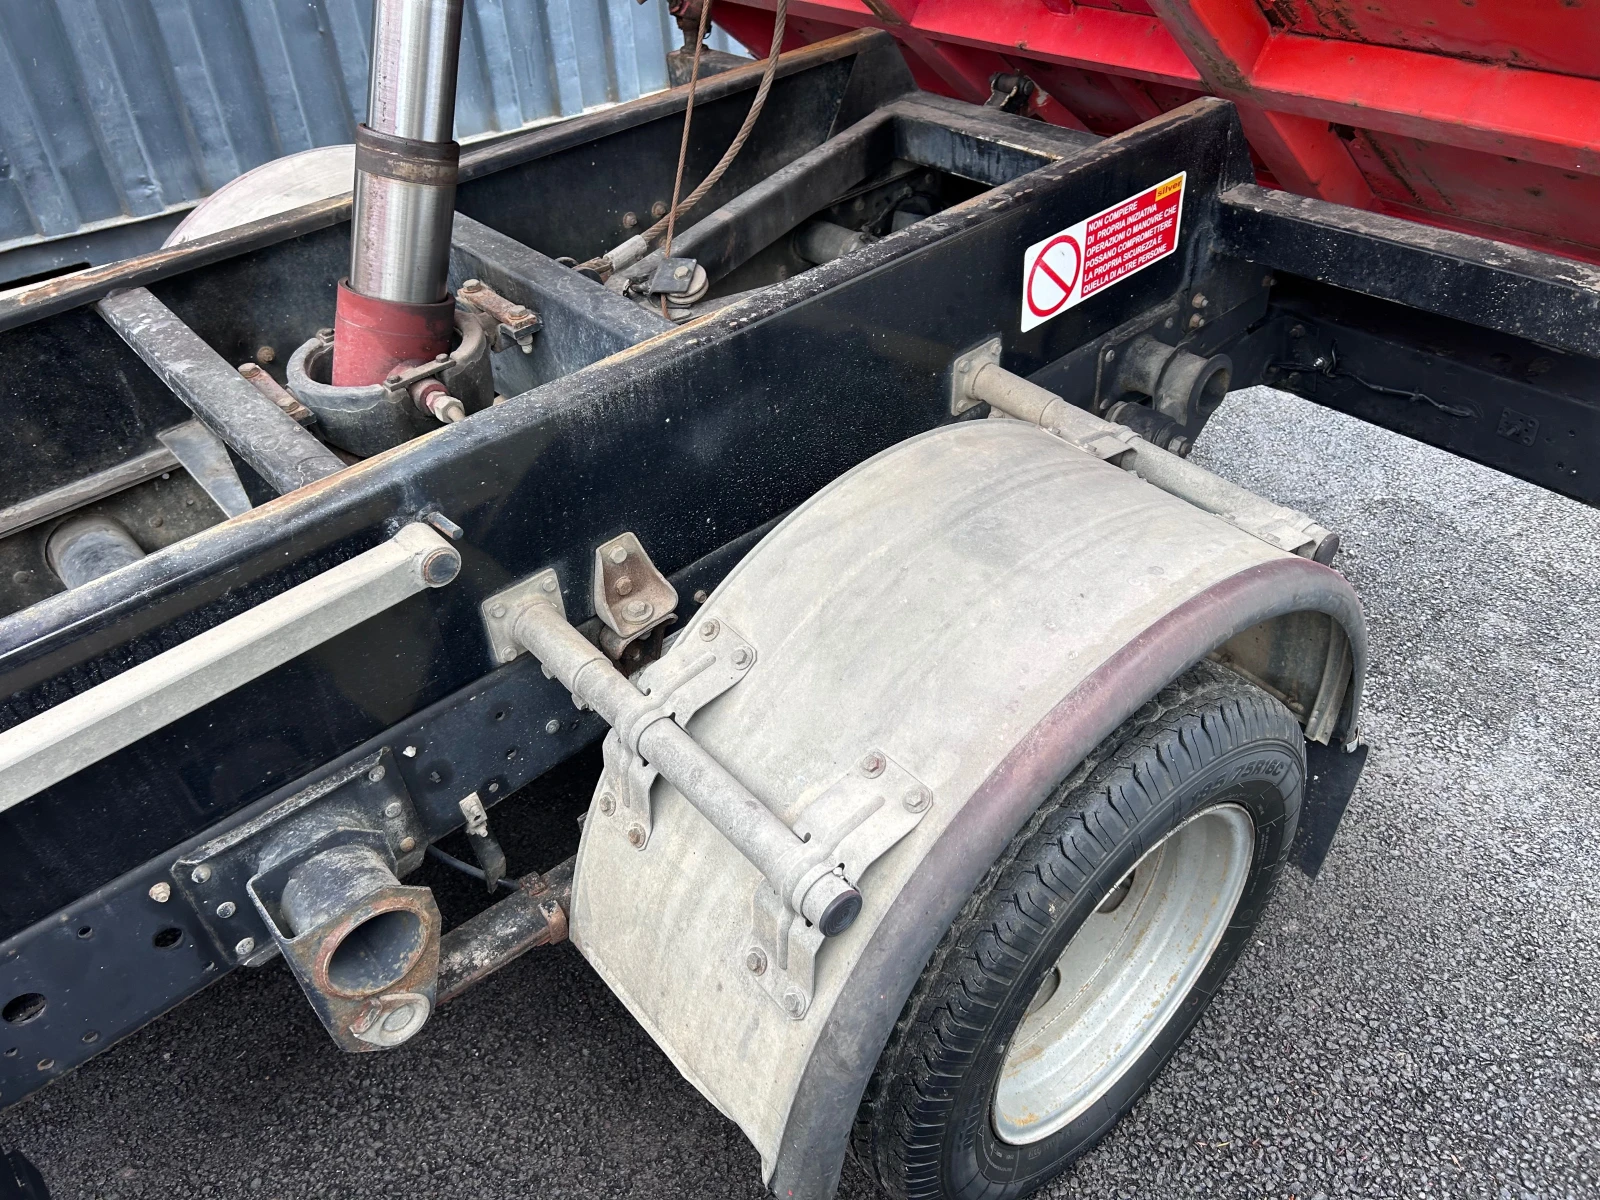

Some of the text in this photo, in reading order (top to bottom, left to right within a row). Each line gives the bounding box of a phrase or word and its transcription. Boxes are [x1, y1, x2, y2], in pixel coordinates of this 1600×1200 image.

[1157, 181, 1182, 196] silver
[1086, 205, 1177, 257] OPERAZIONI O MANOVRE CHE
[1087, 203, 1157, 245] DI PROPRIA INIZIATIVA
[1088, 202, 1138, 232] NON COMPIERE
[1084, 235, 1162, 282] LA PROPRIA SICUREZZA E
[1085, 218, 1173, 269] POSSANO COMPROMETTERE
[1083, 244, 1167, 293] QUELLA DI ALTRE PERSONE
